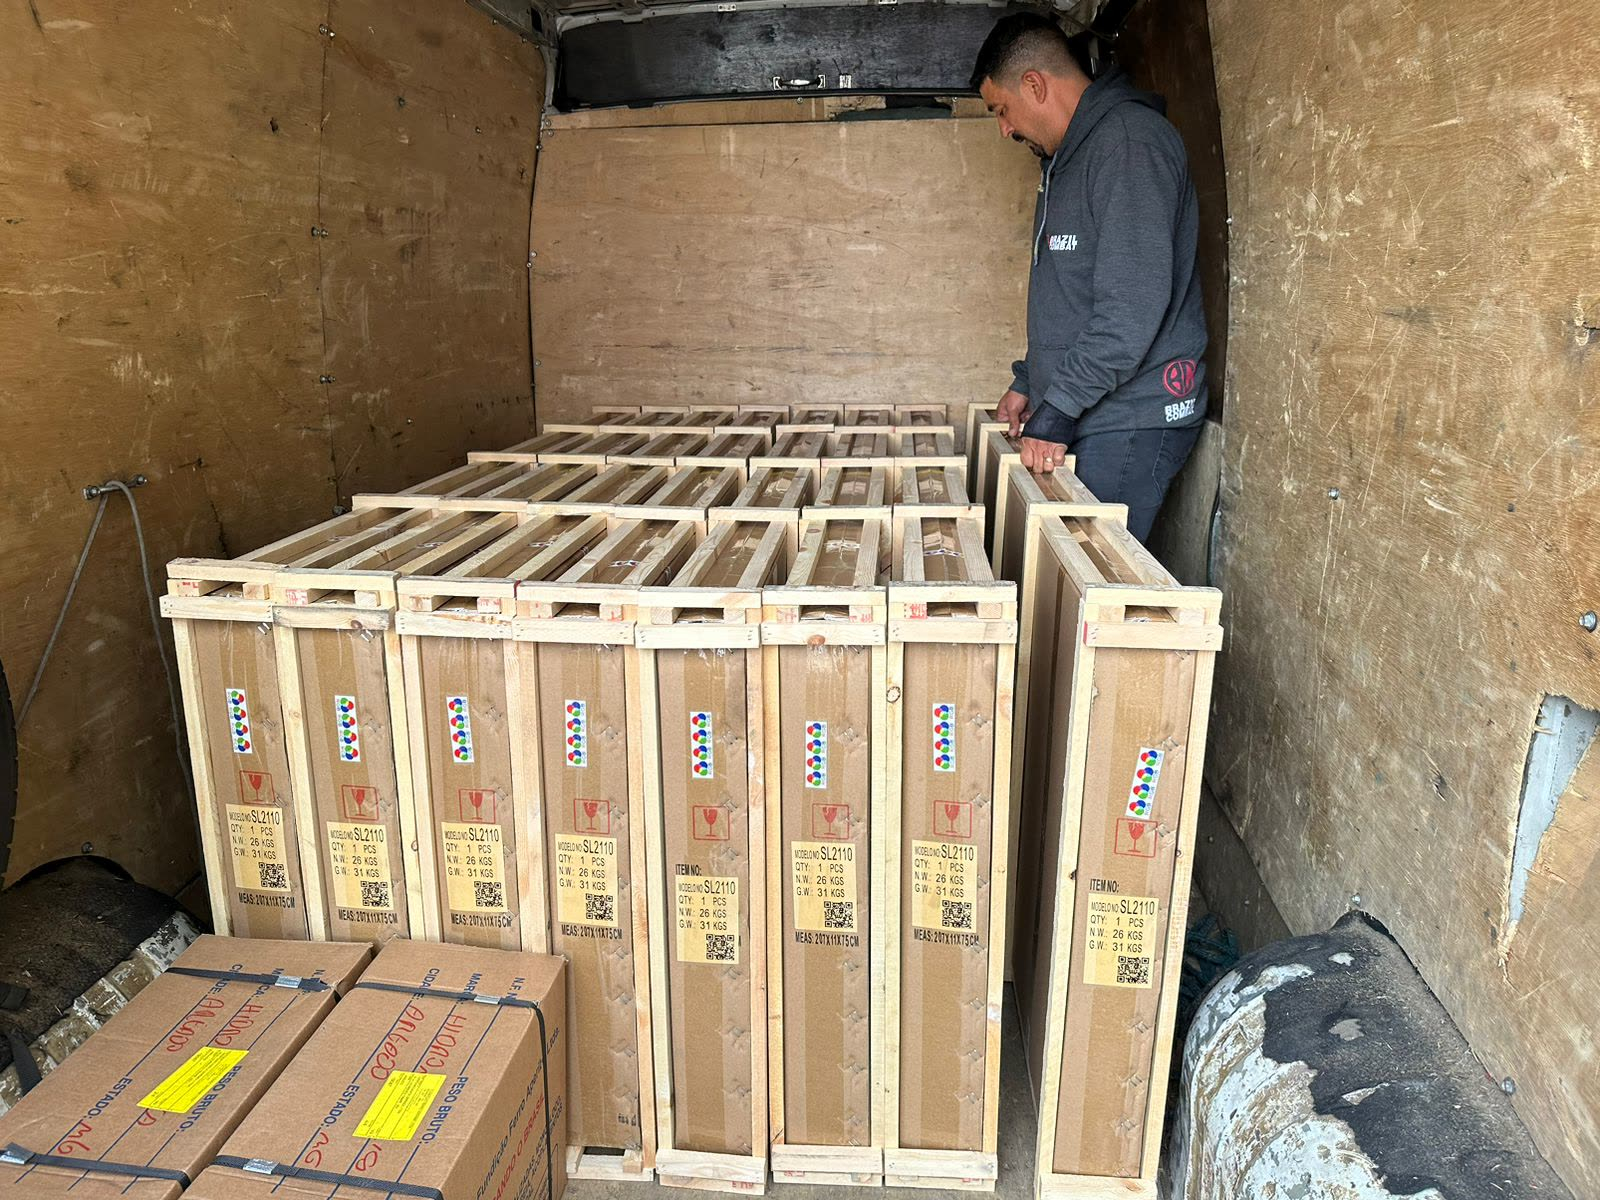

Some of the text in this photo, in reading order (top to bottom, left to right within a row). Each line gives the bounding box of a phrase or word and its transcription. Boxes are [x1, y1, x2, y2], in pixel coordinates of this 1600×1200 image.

[251, 810, 280, 825] SL2110
[261, 827, 273, 836] PCS
[354, 827, 384, 842] SL2110
[468, 828, 499, 842] SL2110
[250, 838, 259, 846] 26
[583, 839, 613, 855] SL2110
[364, 845, 376, 854] PCS
[478, 844, 492, 853] PCS
[821, 846, 852, 861] SL2110
[941, 844, 974, 861] SL2110
[264, 851, 276, 859] KGS
[352, 856, 361, 864] 26
[364, 857, 378, 866] KGS
[466, 856, 475, 864] 26
[479, 857, 492, 866] KGS
[592, 857, 605, 866] PCS
[938, 861, 942, 870] 1
[950, 863, 964, 872] PCS
[354, 868, 363, 876] 31
[366, 869, 380, 877] KGS
[468, 868, 477, 877] 31
[480, 869, 494, 878] KGS
[579, 868, 588, 877] 26
[592, 870, 605, 878] KGS
[676, 864, 702, 876] ITEM NO:
[818, 864, 822, 872] 1
[830, 864, 844, 873] PCS
[580, 880, 589, 889] 31
[592, 882, 606, 890] KGS
[817, 876, 826, 884] 26
[830, 876, 844, 885] KGS
[936, 874, 946, 883] 26
[950, 875, 964, 885] KGS
[704, 880, 735, 894] SL2110
[1090, 879, 1119, 892] ITEM NO:
[818, 888, 827, 897] 31
[831, 889, 845, 897] KGS
[936, 886, 946, 896] 31
[950, 888, 964, 897] KGS
[702, 897, 705, 905] 1
[713, 897, 726, 906] PCS
[1120, 900, 1155, 915] SL2110
[700, 909, 709, 918] 26
[713, 910, 726, 918] KGS
[700, 921, 710, 930] 31
[713, 922, 727, 930] KGS
[1116, 917, 1120, 926] 1
[1129, 918, 1144, 928] PCS
[1113, 929, 1124, 938] 26
[1127, 930, 1143, 940] KGS
[1112, 942, 1123, 952] 31
[1127, 944, 1142, 953] KGS
[412, 968, 440, 1000] CIDAE:
[213, 1065, 242, 1092] PESO
[84, 1076, 133, 1119] ESTADO:
[319, 1084, 360, 1128] ESTADO:
[419, 1076, 469, 1145] PESO BRUTO:
[176, 1093, 220, 1132] BRUTO:
[509, 1098, 526, 1137] Ferro
